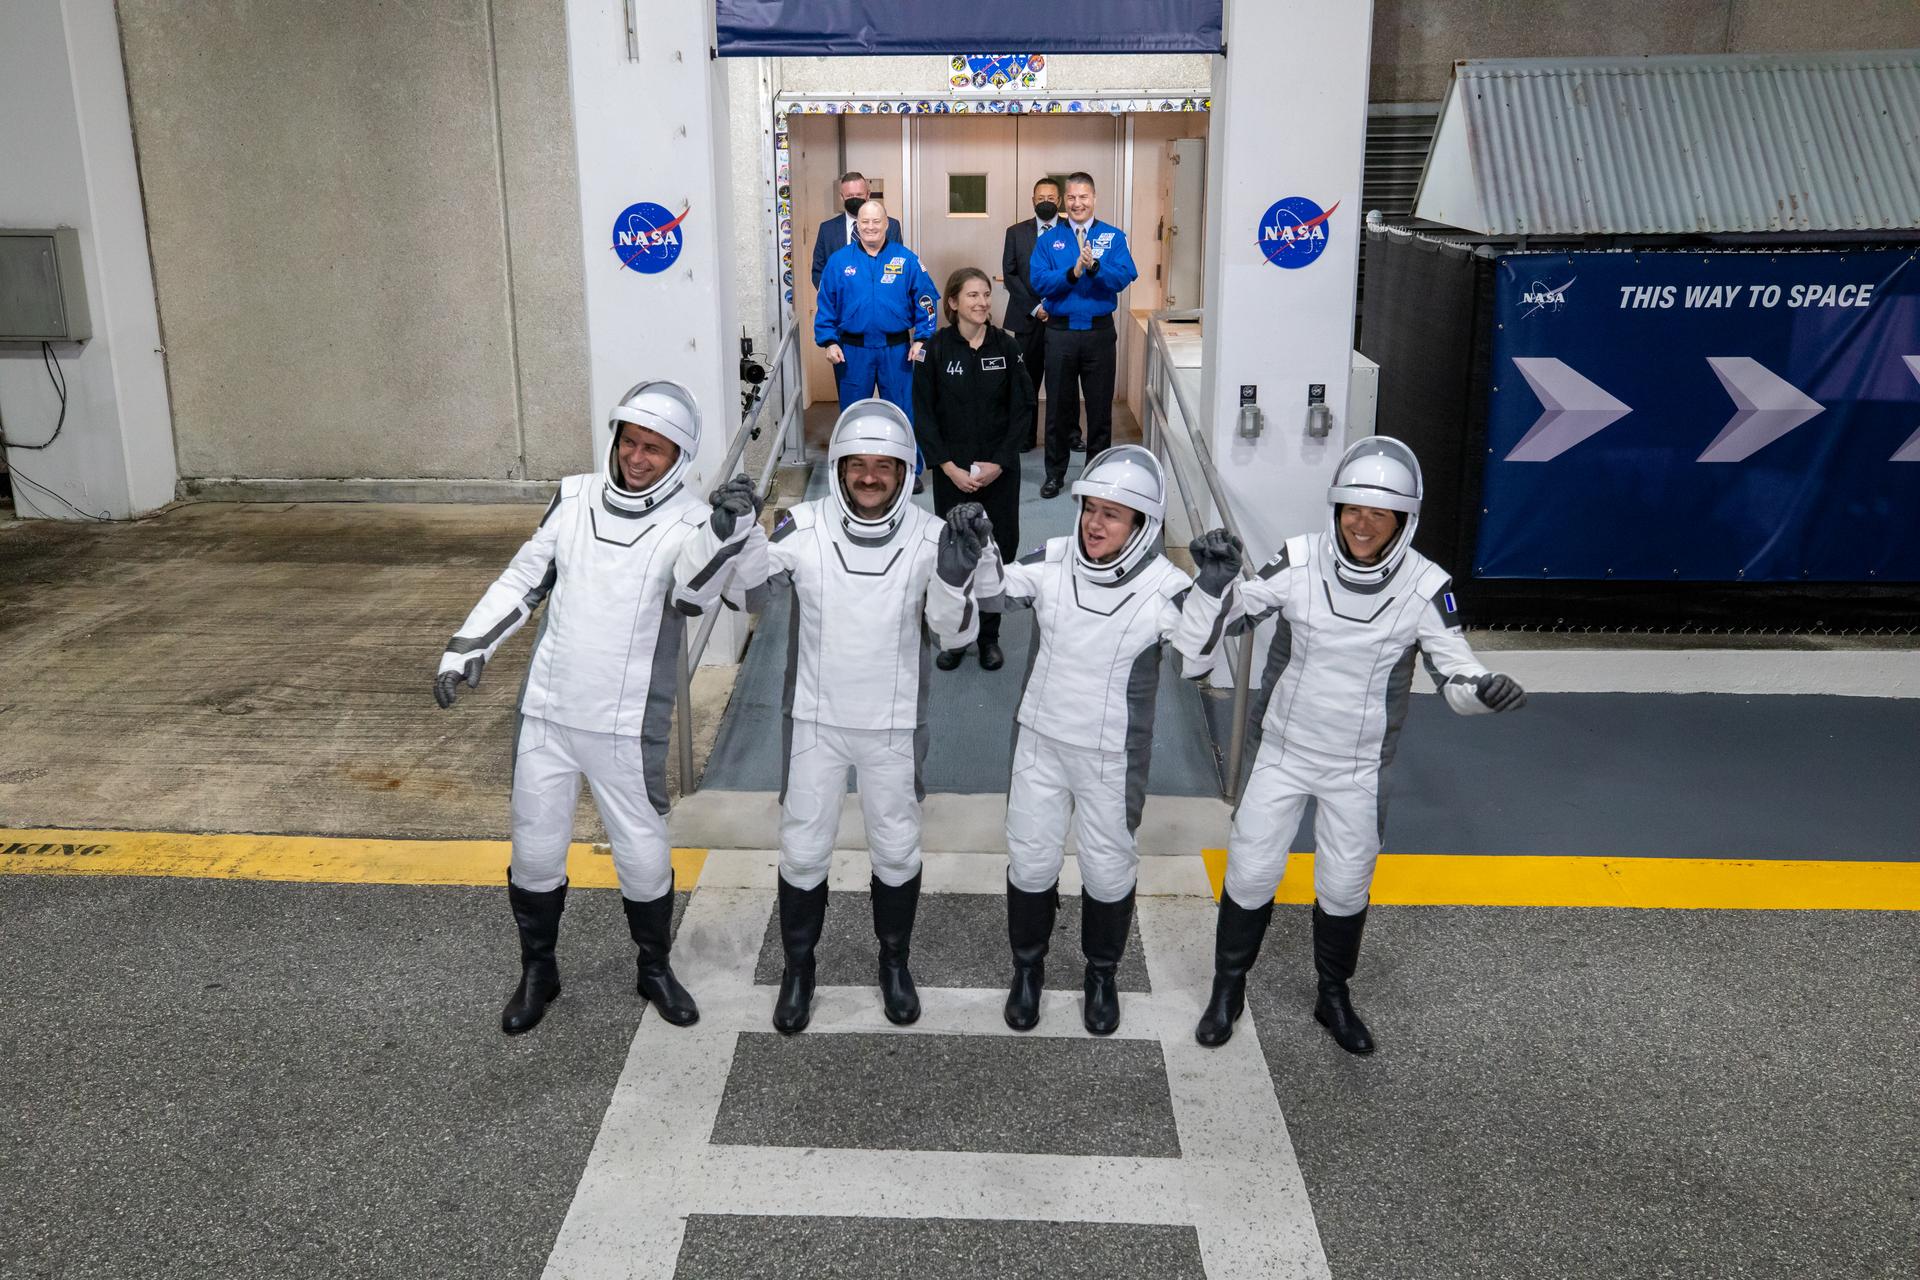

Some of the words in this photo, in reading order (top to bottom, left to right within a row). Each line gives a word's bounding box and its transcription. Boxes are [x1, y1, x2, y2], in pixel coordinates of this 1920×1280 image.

[618, 230, 679, 246] NASA
[1264, 225, 1325, 241] NASA
[1523, 292, 1566, 303] NASA
[1619, 285, 1677, 309] THIS
[1684, 285, 1743, 309] WAY
[1748, 285, 1782, 308] TO
[1787, 284, 1875, 308] SPACE
[946, 361, 964, 375] 44
[0, 843, 111, 856] KING
